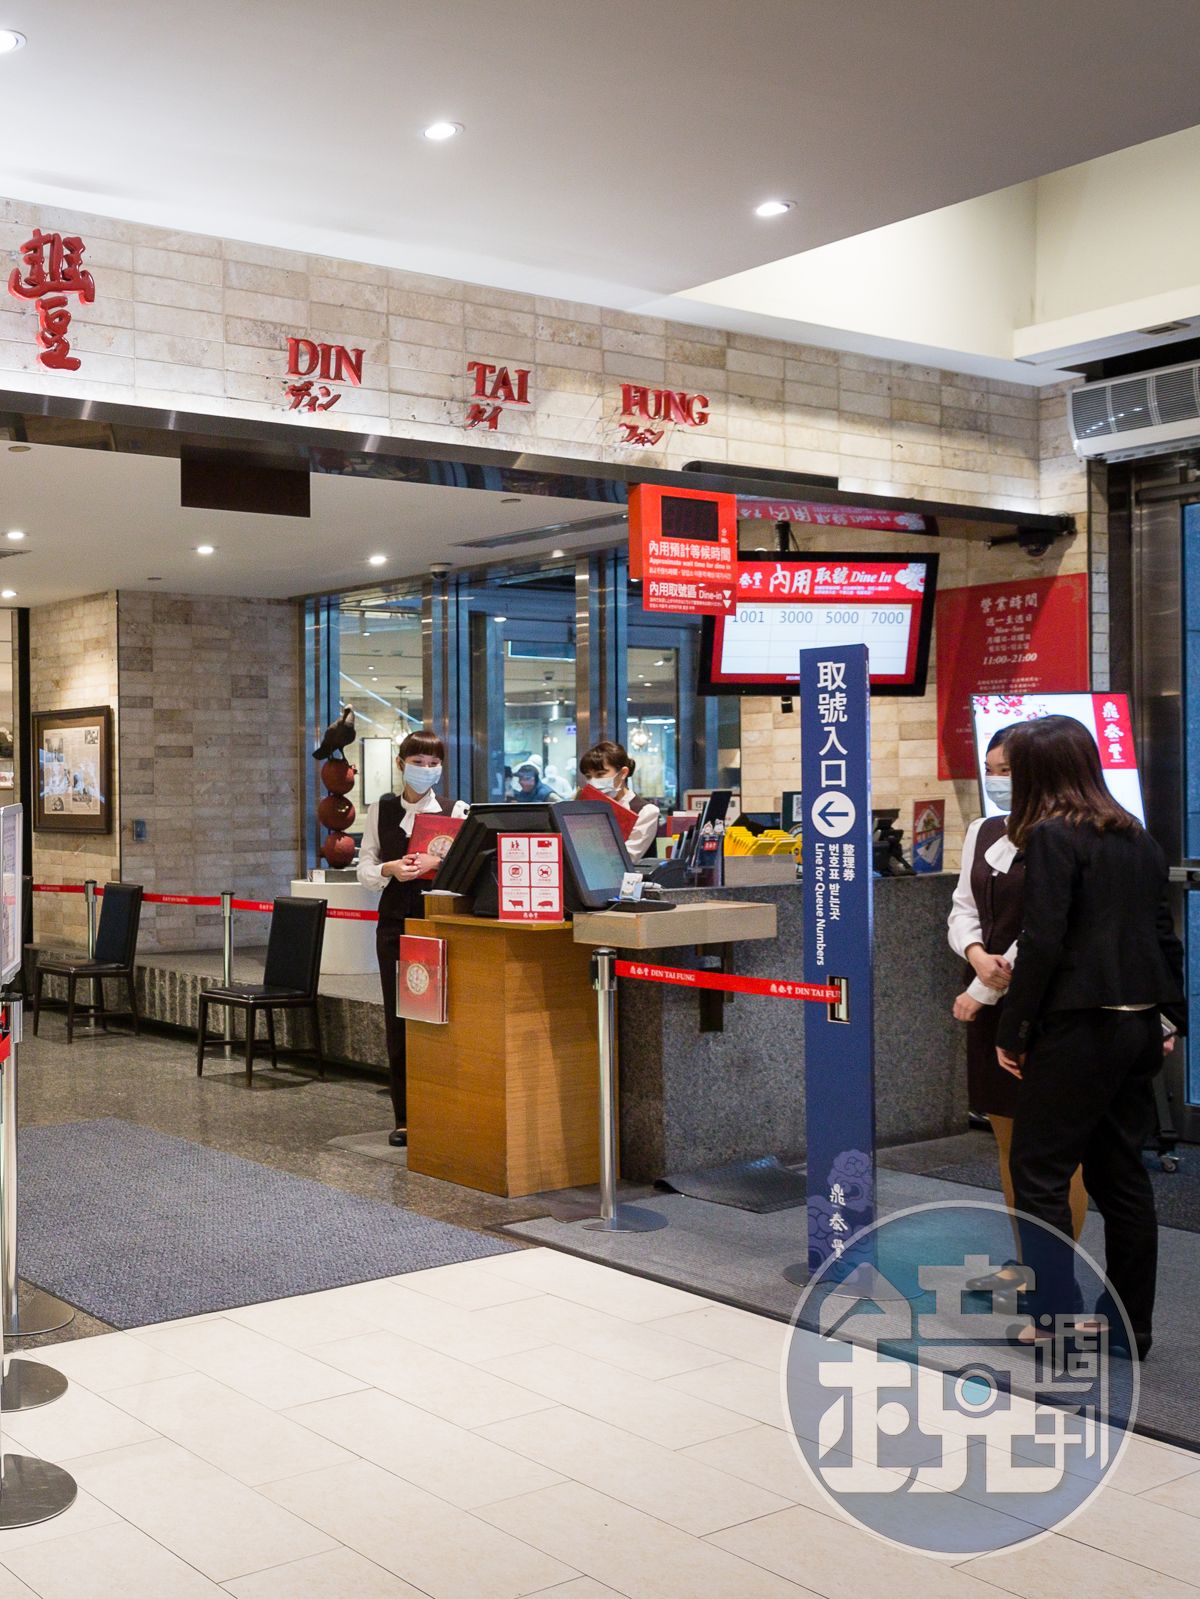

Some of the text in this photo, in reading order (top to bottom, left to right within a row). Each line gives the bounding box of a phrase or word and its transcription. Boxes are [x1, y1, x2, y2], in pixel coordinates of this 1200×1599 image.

[285, 336, 710, 427] DIN TAI FUNG
[850, 571, 878, 583] Dine
[879, 571, 893, 583] In
[980, 592, 1038, 613] 營業時間
[779, 610, 813, 624] 3000
[825, 611, 859, 624] 5000
[871, 611, 904, 624] 7000
[982, 652, 1038, 666] 11:00-21:00
[816, 660, 848, 788] 取號入口
[814, 843, 826, 965] Line for Queue Numbers
[651, 969, 663, 978] DIN
[665, 970, 676, 979] TAI
[676, 972, 695, 982] FUNG
[795, 986, 810, 996] DIN
[811, 988, 825, 997] TAI
